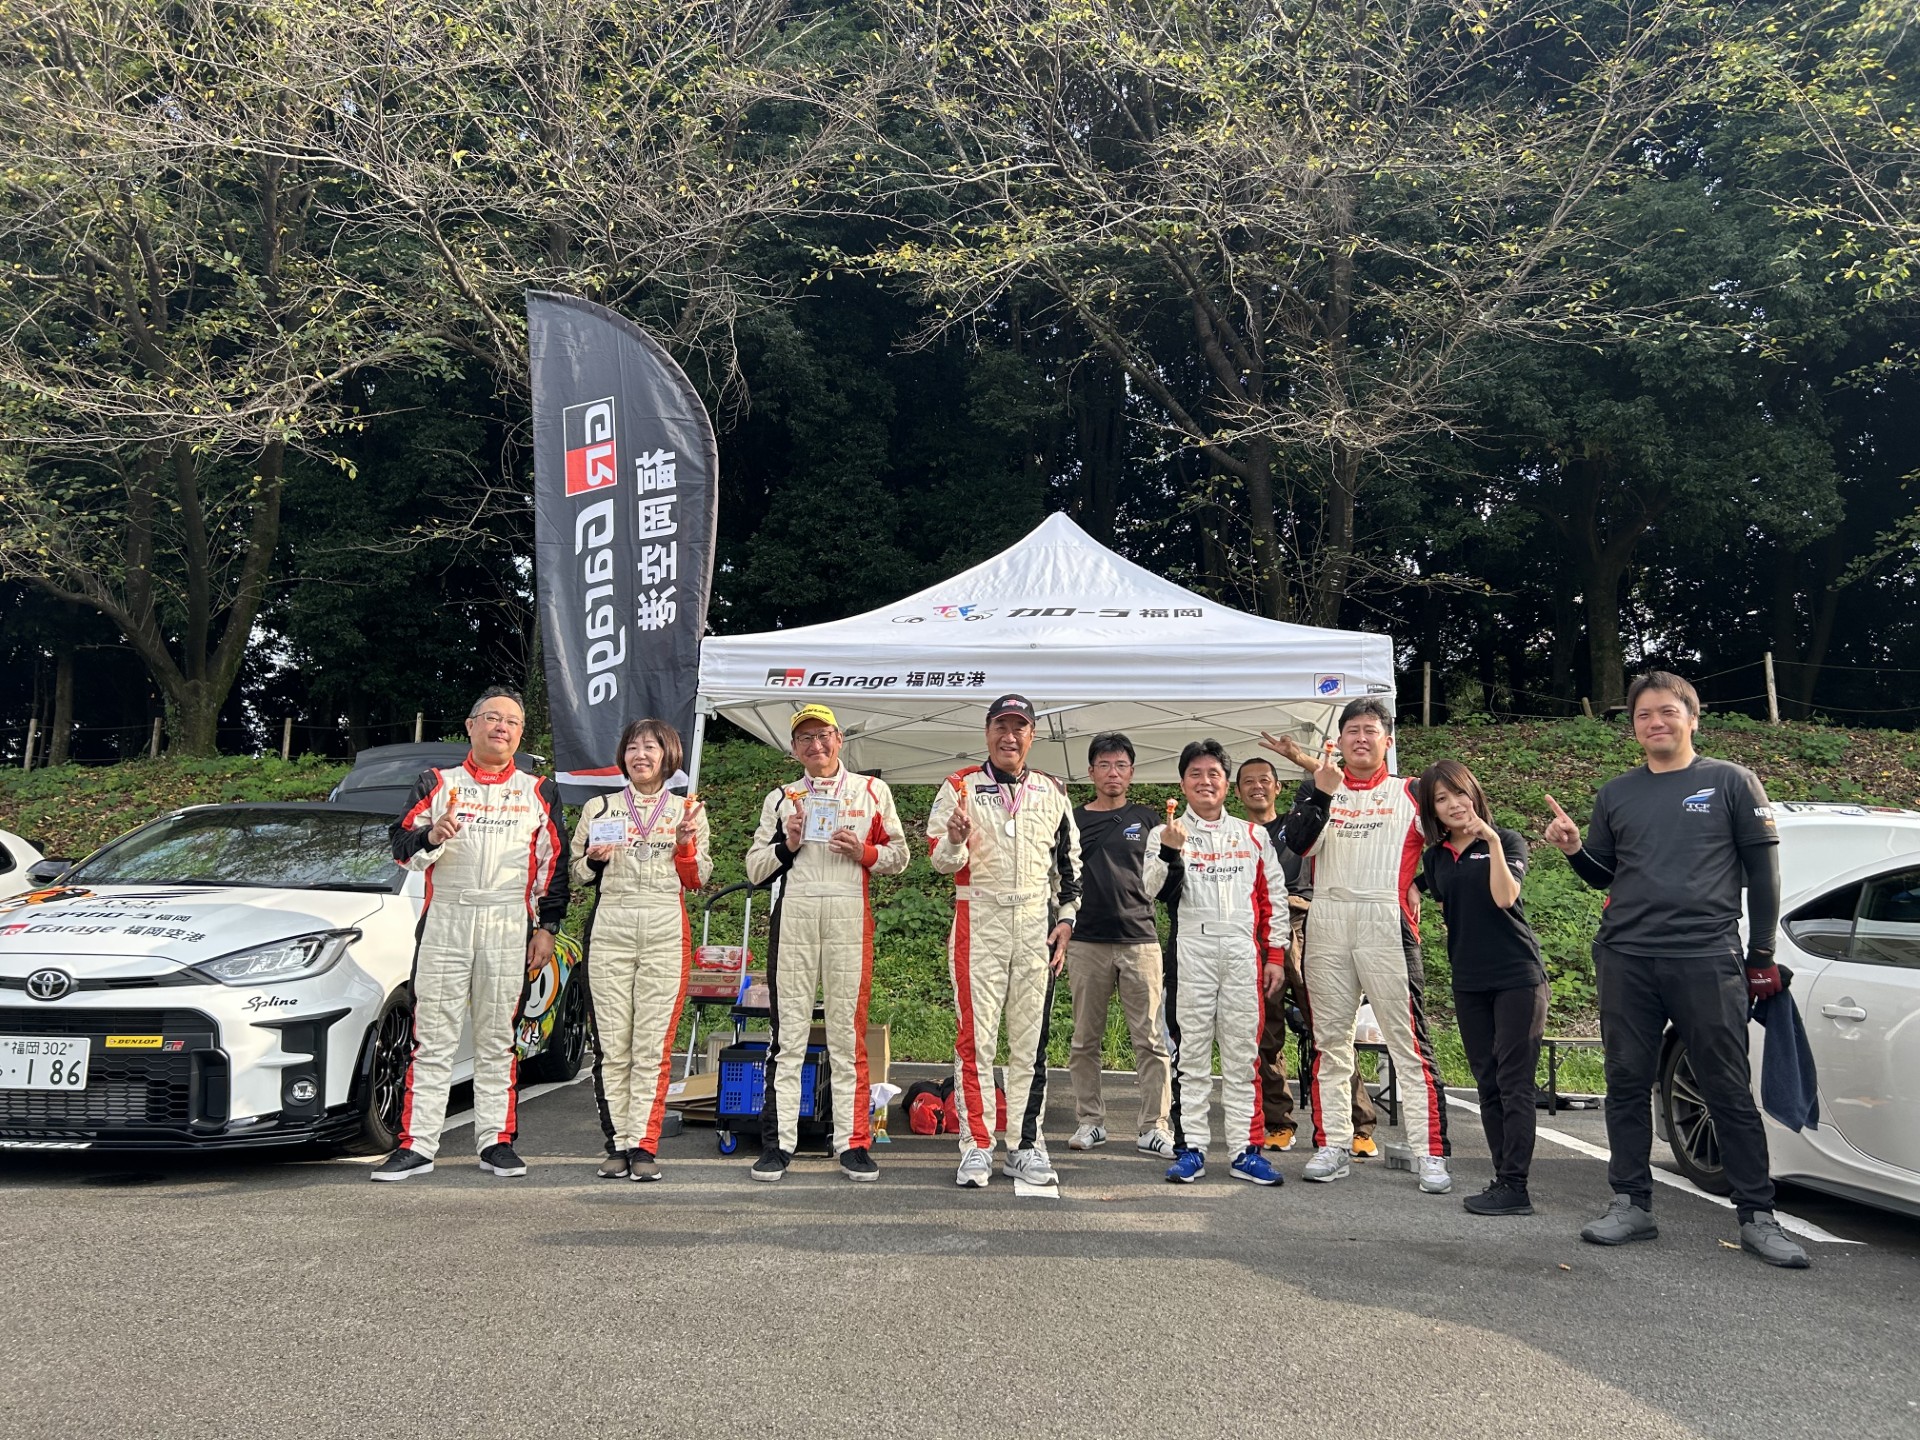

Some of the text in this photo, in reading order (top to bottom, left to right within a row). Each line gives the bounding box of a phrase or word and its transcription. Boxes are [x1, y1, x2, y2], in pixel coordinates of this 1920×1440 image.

[807, 671, 898, 690] Garage
[905, 671, 986, 687] 福岡空港
[476, 816, 519, 827] Garage
[1344, 821, 1384, 831] Garage
[24, 924, 119, 936] Garage
[122, 925, 207, 943] 福岡空港
[241, 996, 298, 1012] Spline
[12, 1041, 67, 1056] 福岡 302
